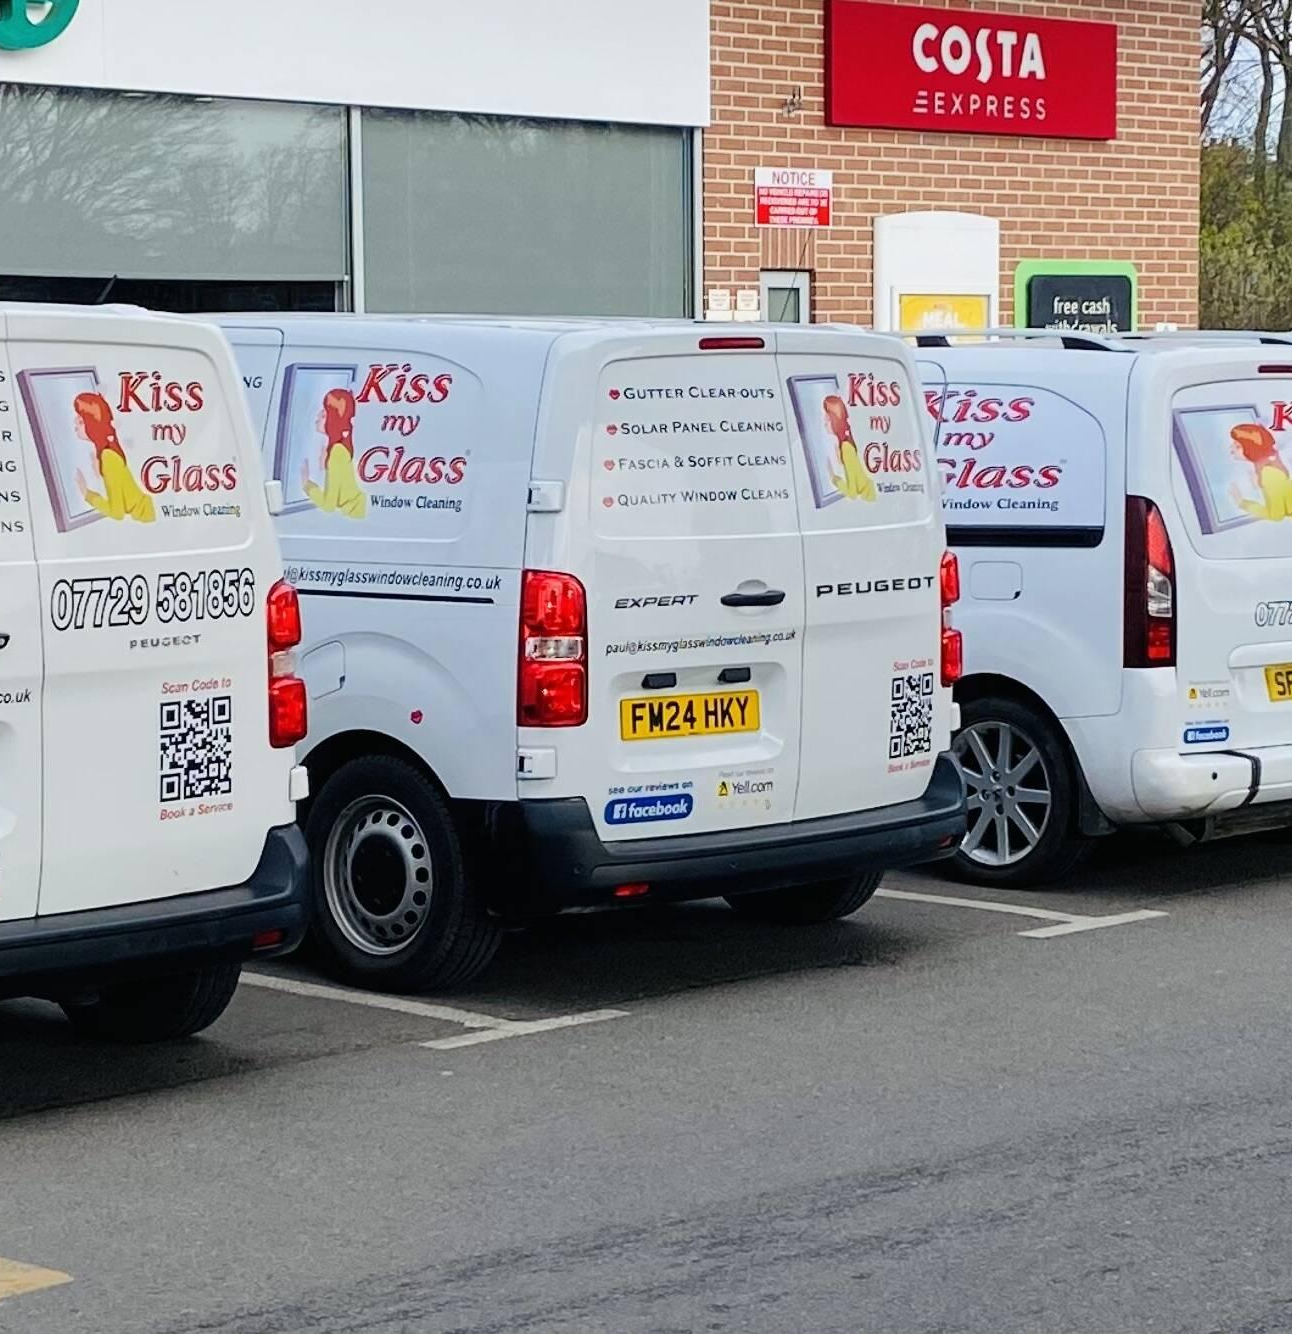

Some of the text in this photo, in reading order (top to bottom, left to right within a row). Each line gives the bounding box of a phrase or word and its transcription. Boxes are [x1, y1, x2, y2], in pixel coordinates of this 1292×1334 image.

[912, 22, 1046, 84] COSTA
[934, 91, 1046, 120] EXPRESS
[772, 171, 816, 186] NOTICE
[1053, 296, 1111, 315] free cash
[116, 371, 204, 413] Kiss
[356, 363, 453, 404] Kiss
[623, 386, 775, 400] GUTTER CLEAR-OUTS
[846, 372, 901, 407] Kiss
[151, 423, 187, 446] my
[380, 413, 421, 437] my
[620, 420, 784, 436] SOLAR PANEL CLEANING
[869, 415, 891, 434] my
[942, 431, 995, 451] my
[358, 446, 468, 485] Glass
[618, 454, 787, 472] FASCIA & SOFFIT CLEANS
[863, 441, 922, 474] Glass
[140, 454, 237, 495] Glass
[370, 494, 463, 514] Window Cleaning
[617, 488, 789, 508] QUALITY WINDOW CLEANS
[996, 498, 1059, 512] Cleaning
[161, 503, 241, 518] Window Cleaning
[816, 575, 935, 598] PEUGEOT
[51, 567, 255, 631] 07729 581856
[614, 594, 699, 609] EXPERT
[129, 633, 202, 650] PEUGEOT
[161, 677, 232, 695] Scan Code to
[631, 696, 749, 734] FM24 HKY
[608, 780, 694, 796] see our reviews on
[731, 779, 773, 795] Yell.com
[159, 801, 234, 821] Book a Service
[628, 800, 688, 818] facebook
